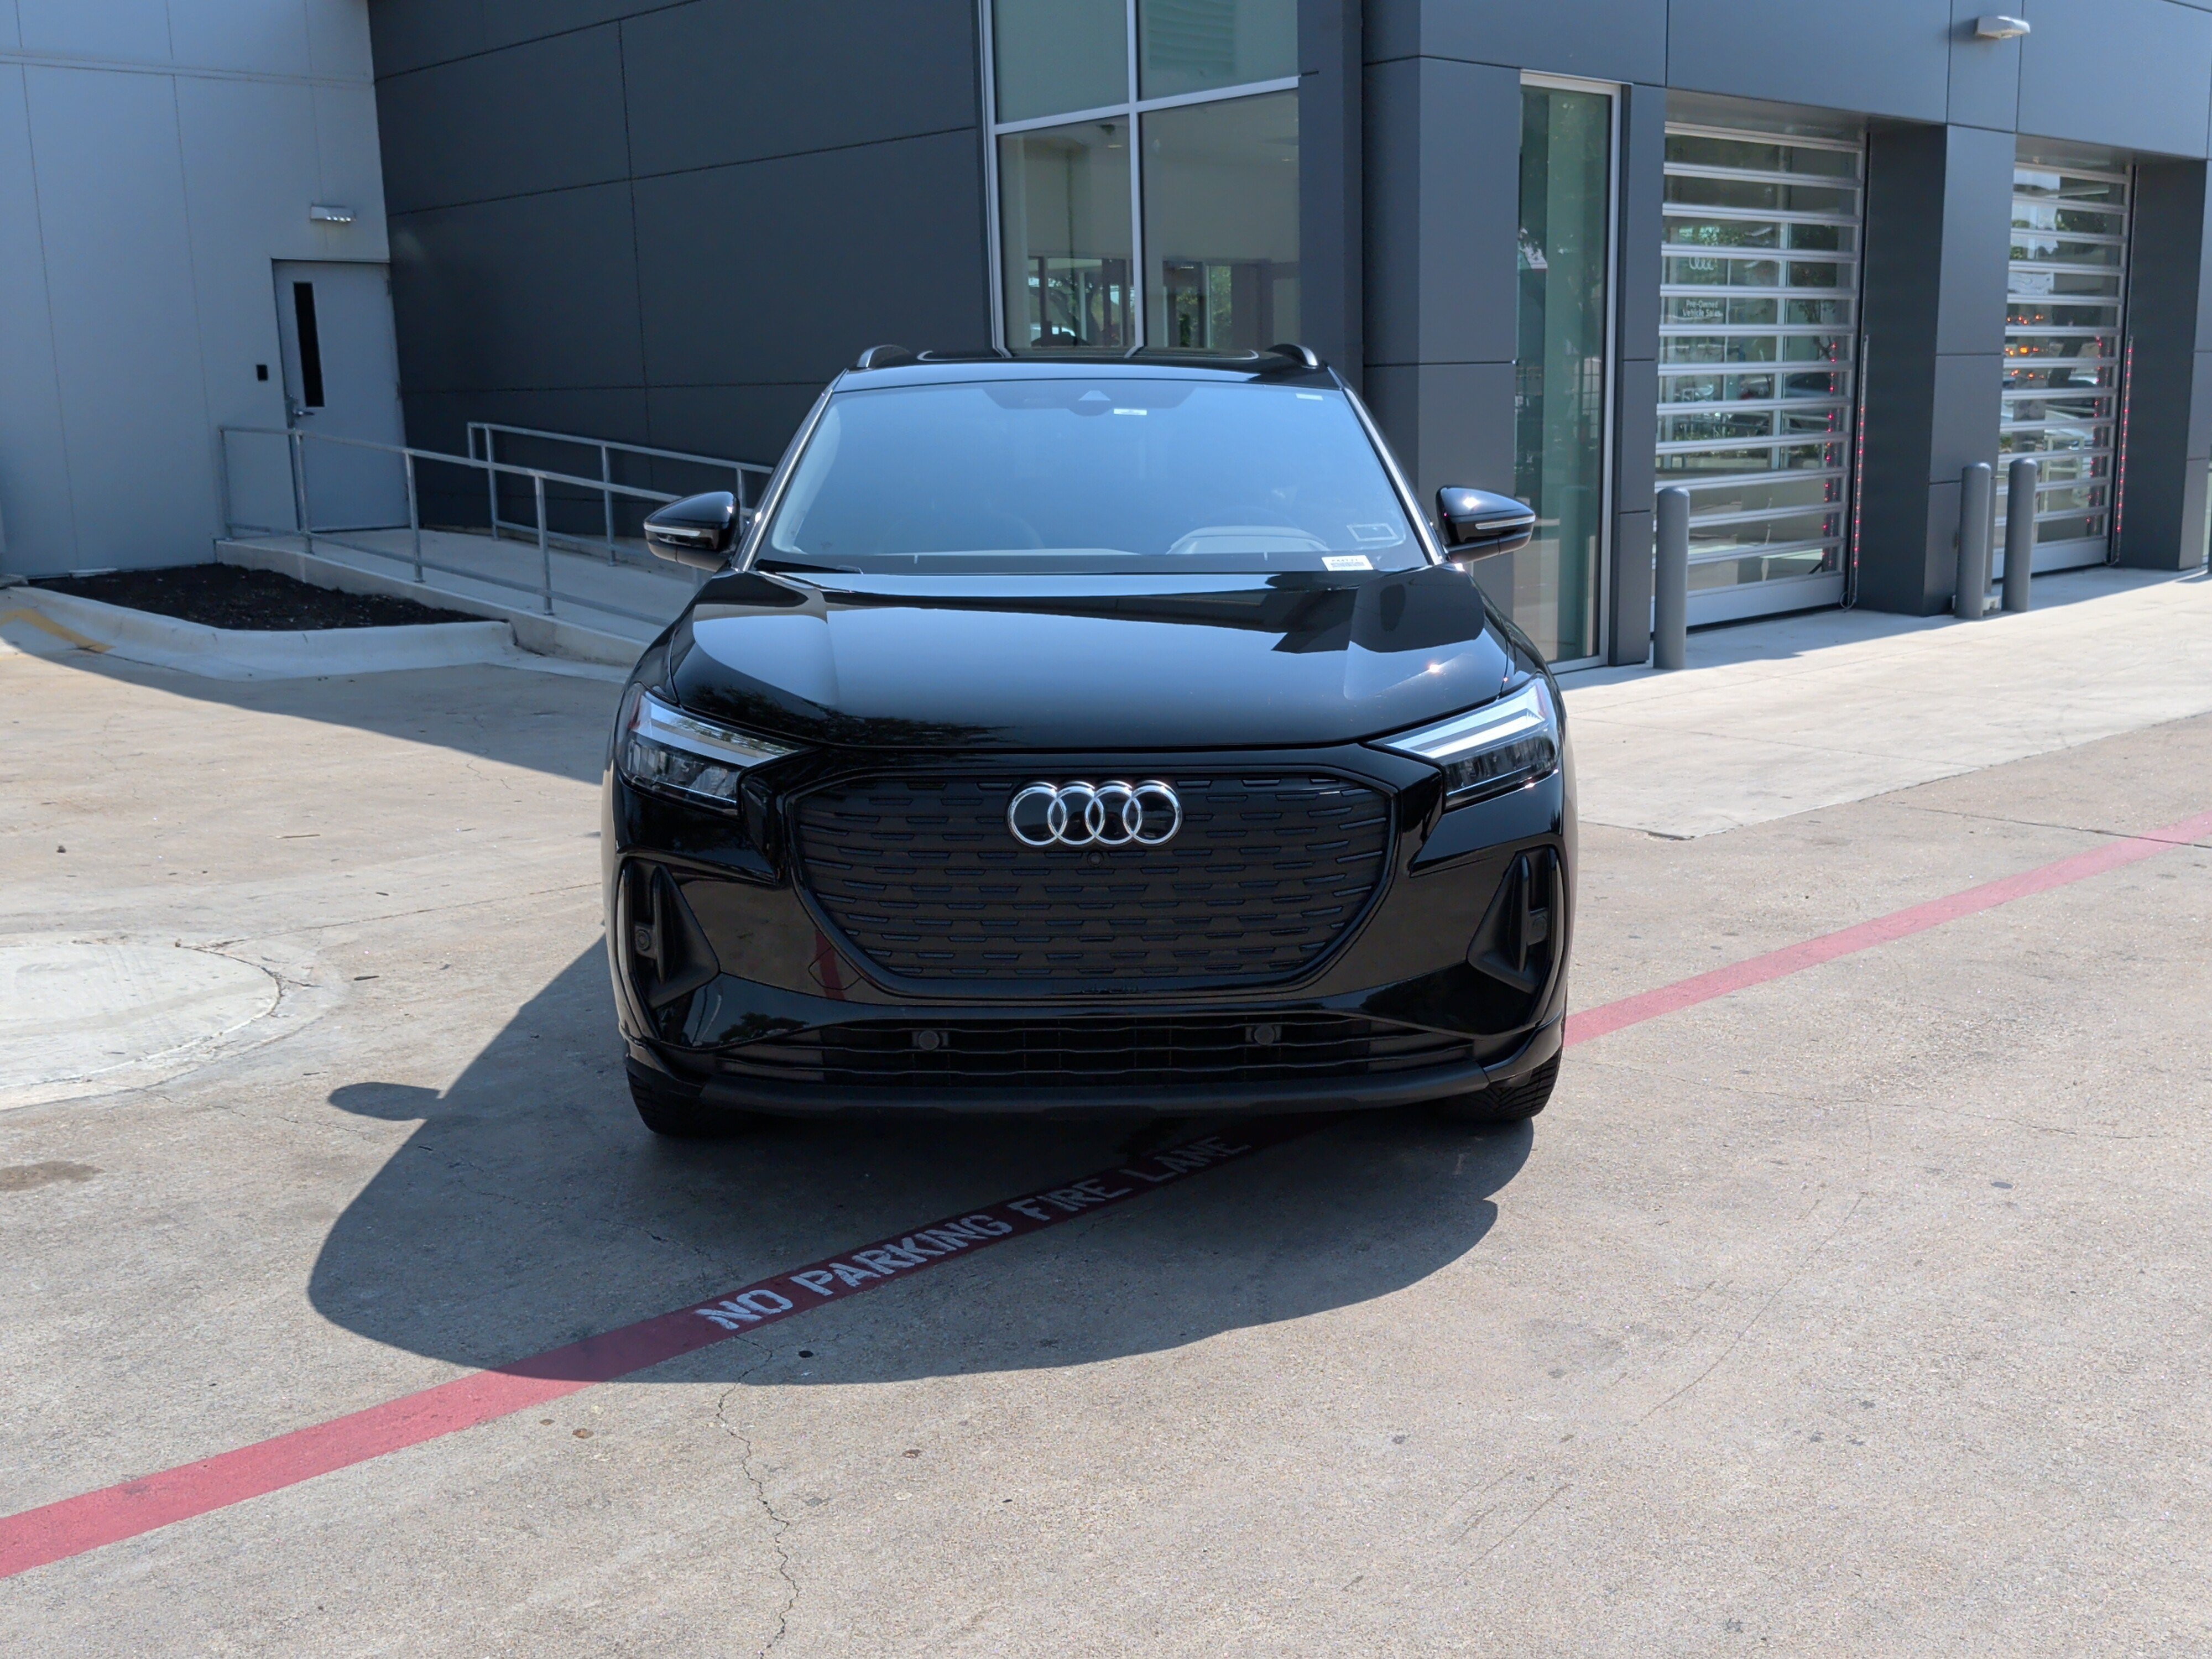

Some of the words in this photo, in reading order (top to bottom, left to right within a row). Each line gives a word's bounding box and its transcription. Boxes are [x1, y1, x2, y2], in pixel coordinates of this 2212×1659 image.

[693, 1288, 793, 1330] NO
[791, 1214, 1013, 1296] PARKING
[1007, 1178, 1133, 1222] FIRE
[1122, 1136, 1251, 1182] LANE
